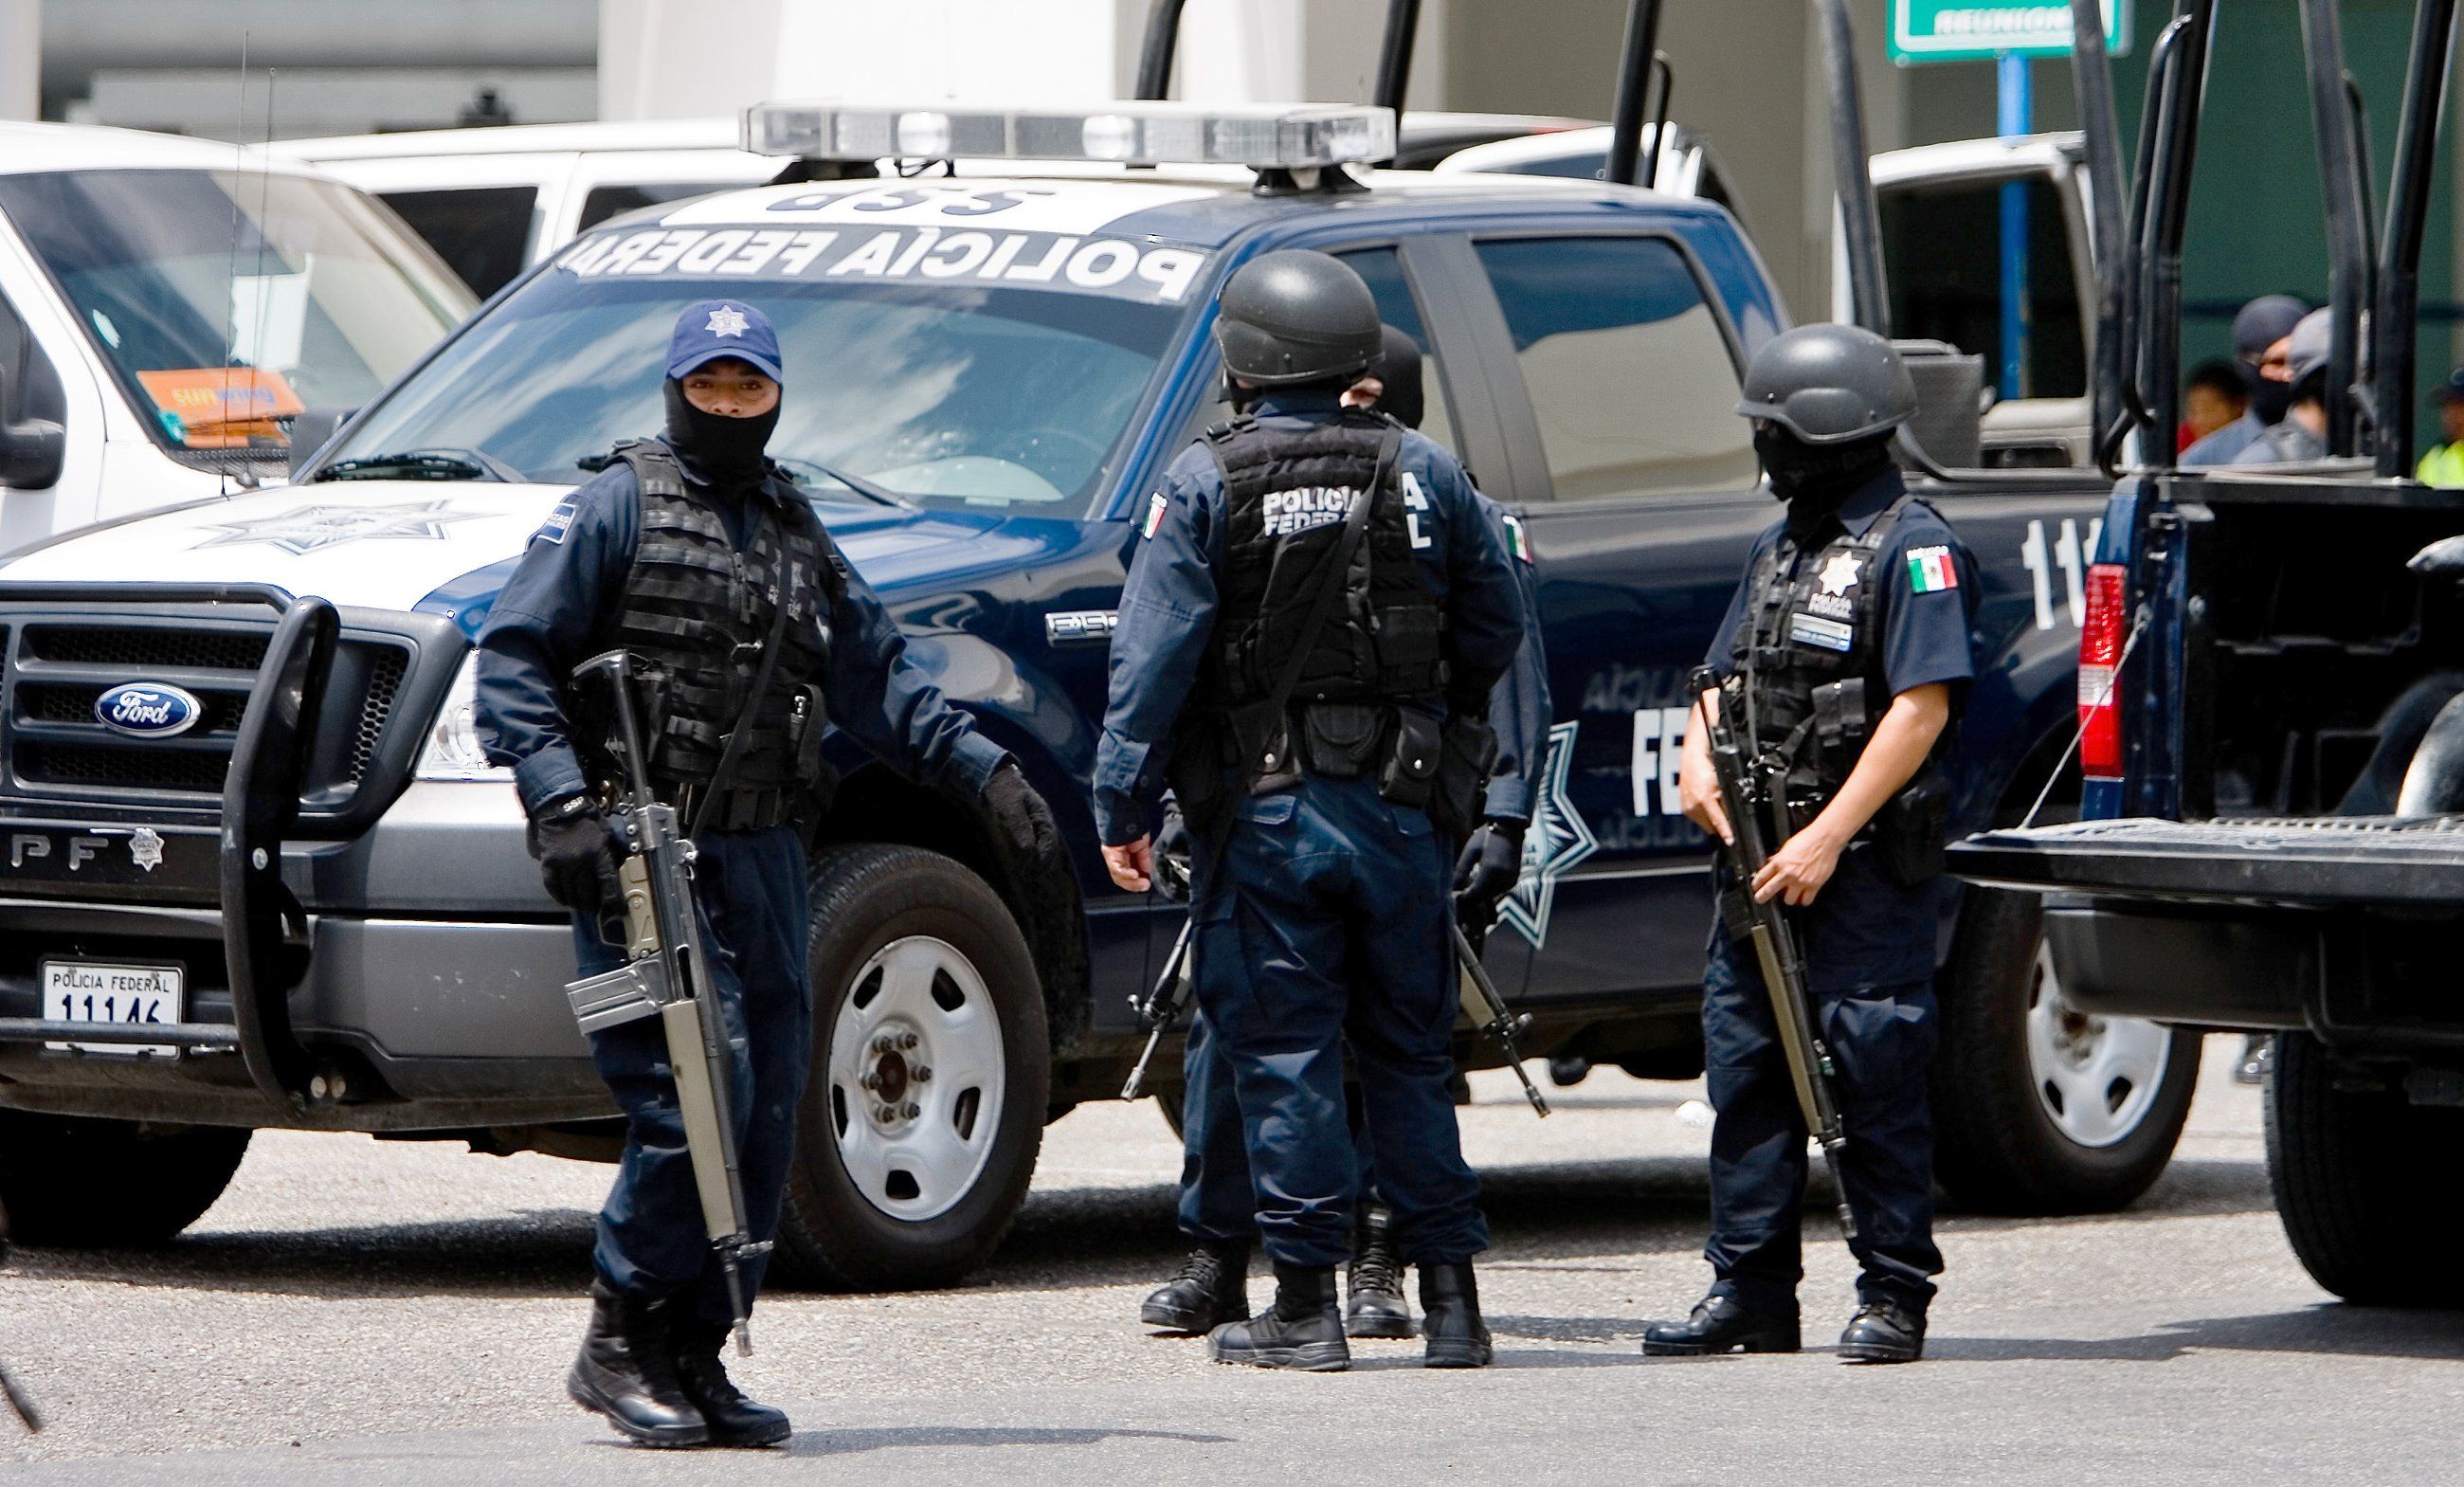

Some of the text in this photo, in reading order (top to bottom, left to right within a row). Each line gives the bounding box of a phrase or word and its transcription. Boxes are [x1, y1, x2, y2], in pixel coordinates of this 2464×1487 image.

[113, 691, 172, 724] Ford
[52, 973, 170, 993] POLICIA FEDERAL
